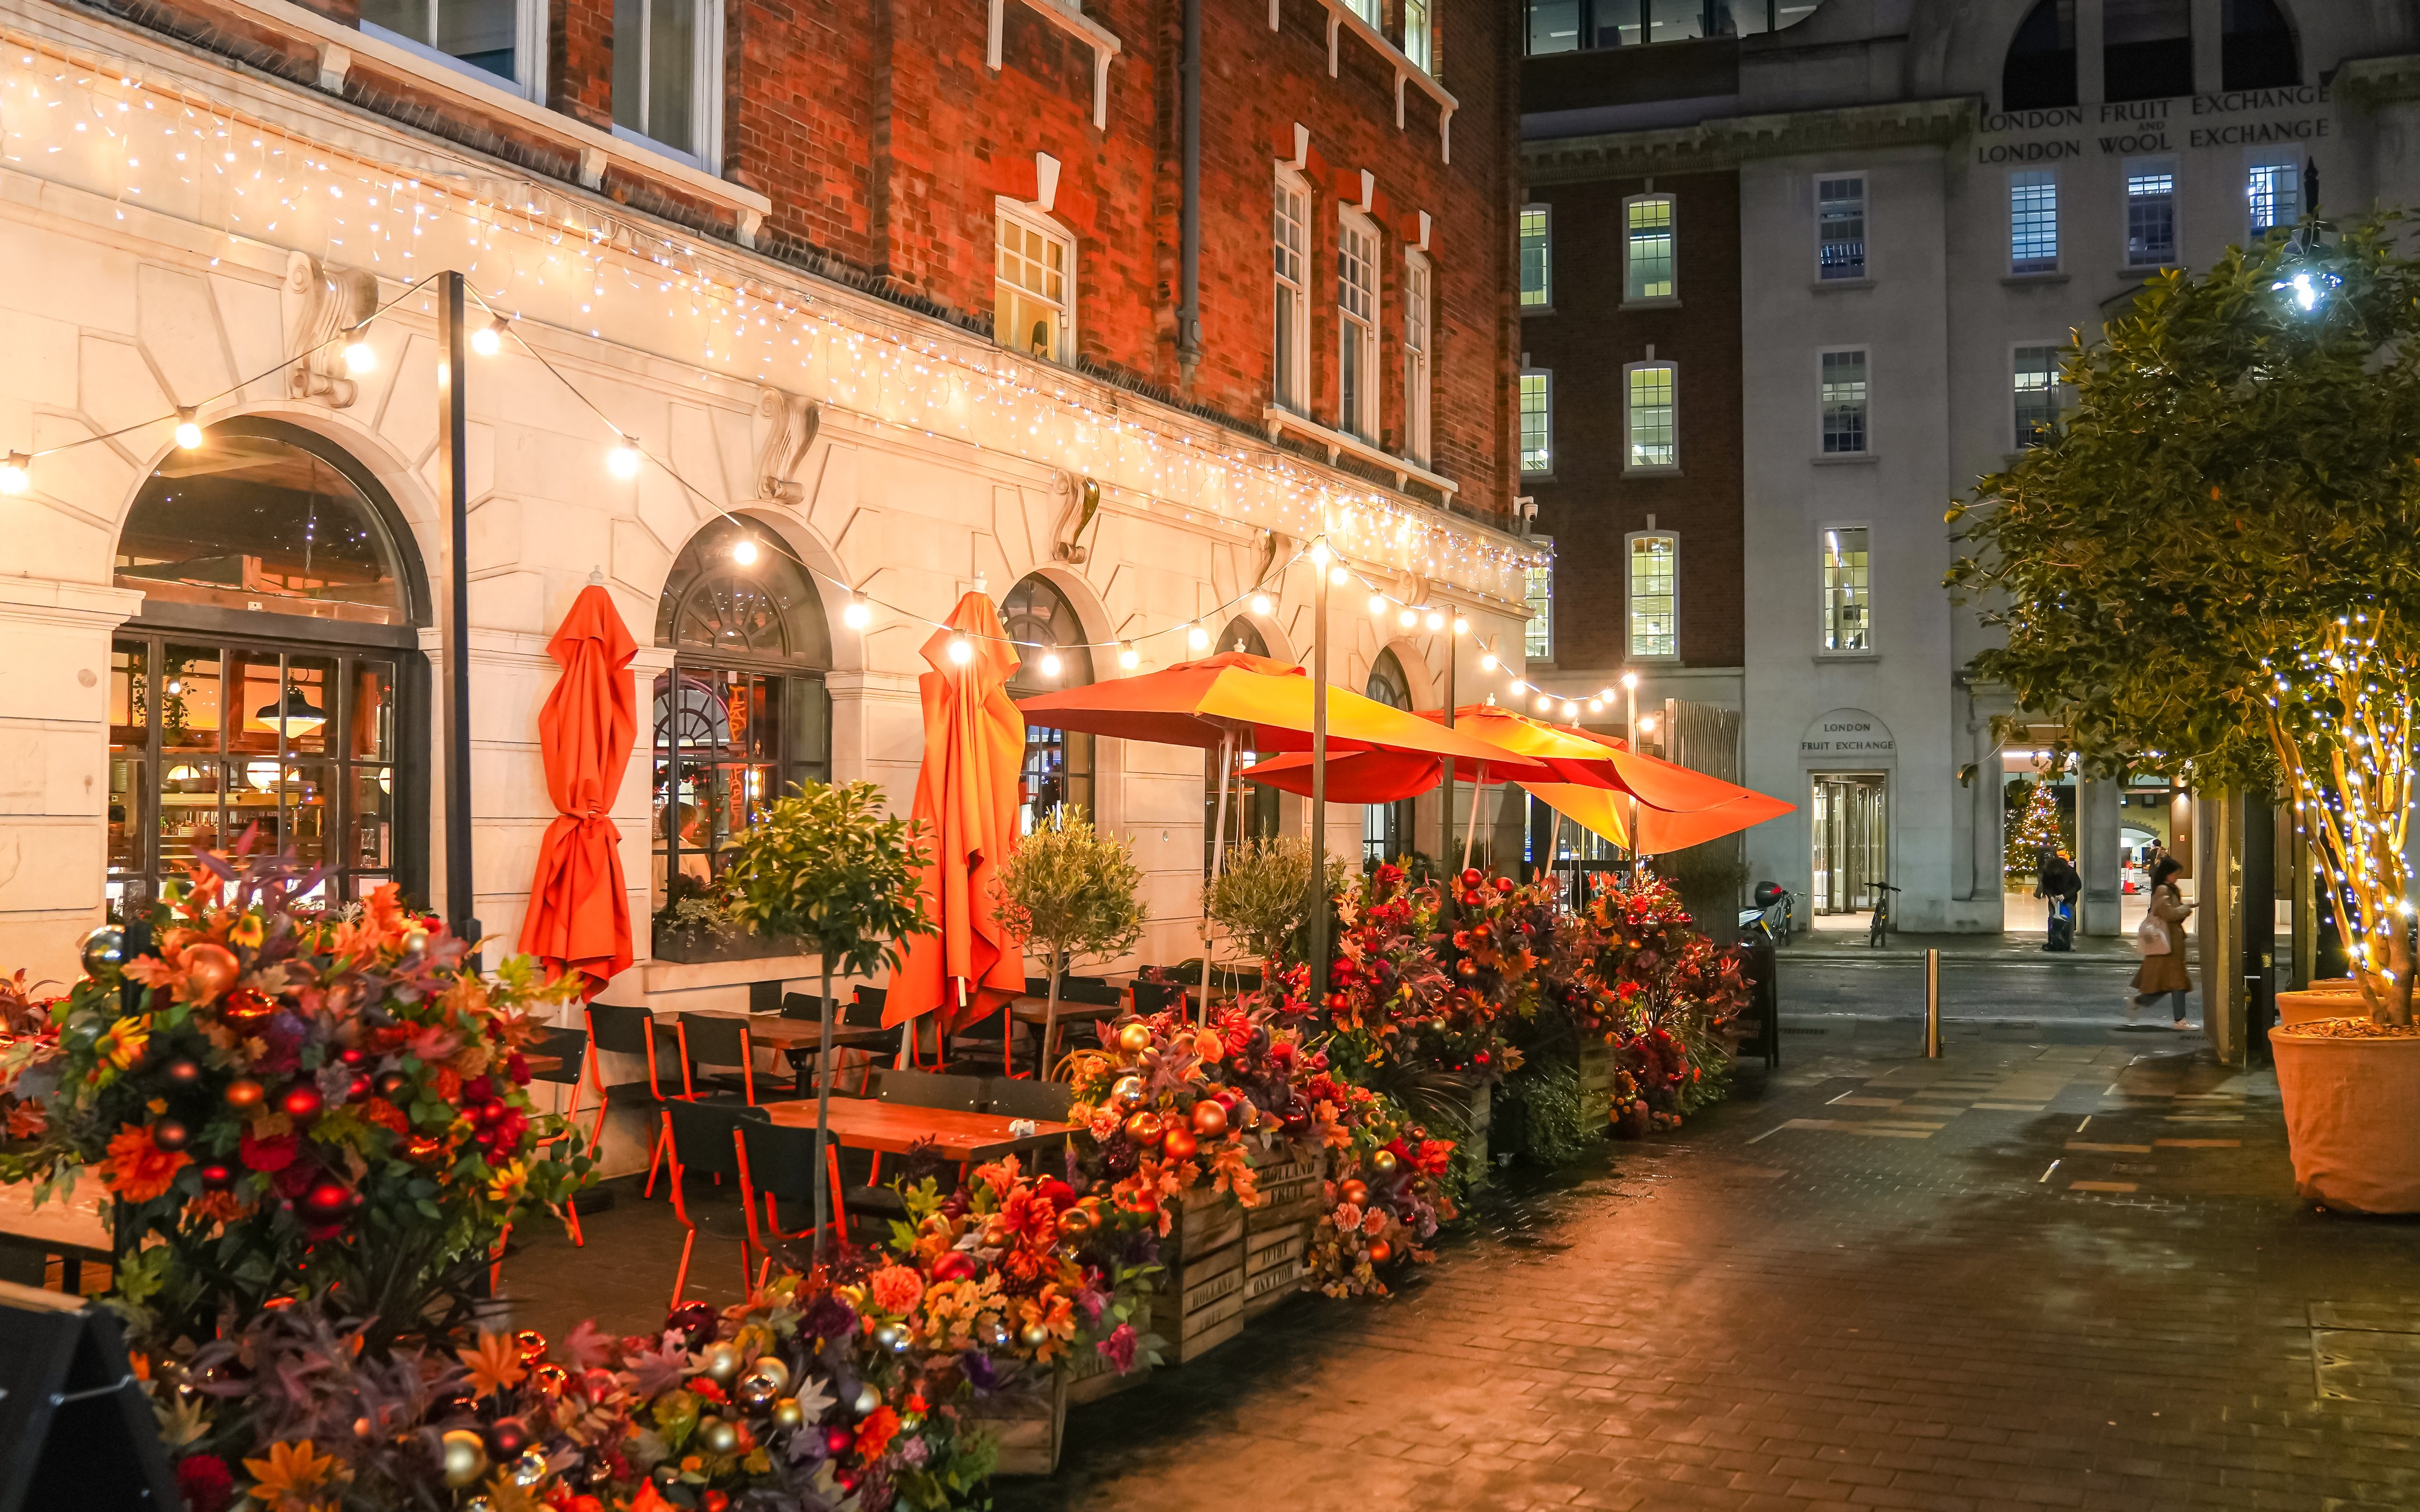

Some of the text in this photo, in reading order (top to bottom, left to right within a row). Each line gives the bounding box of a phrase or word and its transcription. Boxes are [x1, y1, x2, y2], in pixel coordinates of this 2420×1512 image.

[1980, 85, 2330, 133] LONDON FRUIT EXCHANGE
[2138, 121, 2165, 132] AND
[1978, 119, 2329, 164] LONDON WOOL EXCHANGE
[1824, 724, 1870, 732] LONDON
[1836, 741, 1894, 750] EXCHANGE
[1192, 1274, 1234, 1309] HOLLAND
